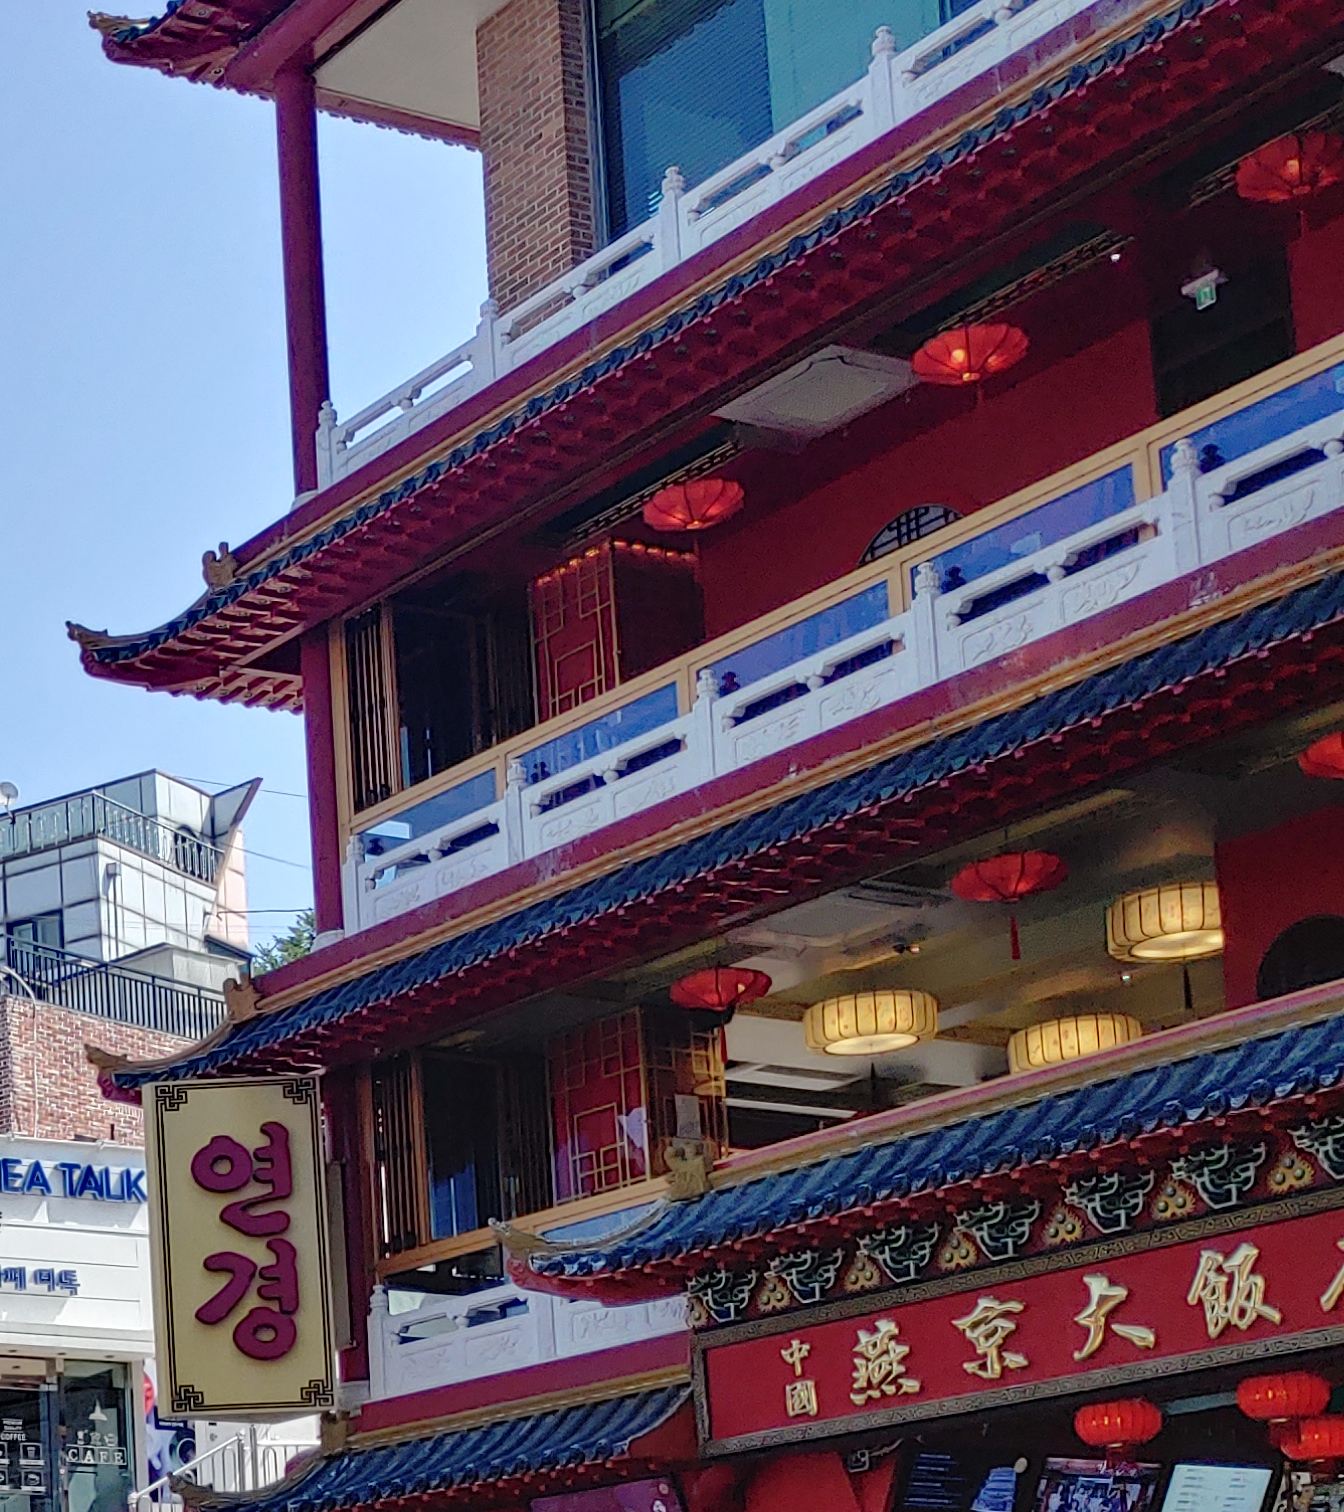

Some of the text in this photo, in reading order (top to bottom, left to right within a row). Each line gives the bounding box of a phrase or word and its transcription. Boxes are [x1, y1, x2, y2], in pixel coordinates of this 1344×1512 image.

[55, 1162, 148, 1203] TALK
[190, 1120, 300, 1361] 연경
[780, 1338, 820, 1418] 中國
[0, 1433, 27, 1441] COFFEE
[67, 1448, 124, 1465] CAFE
